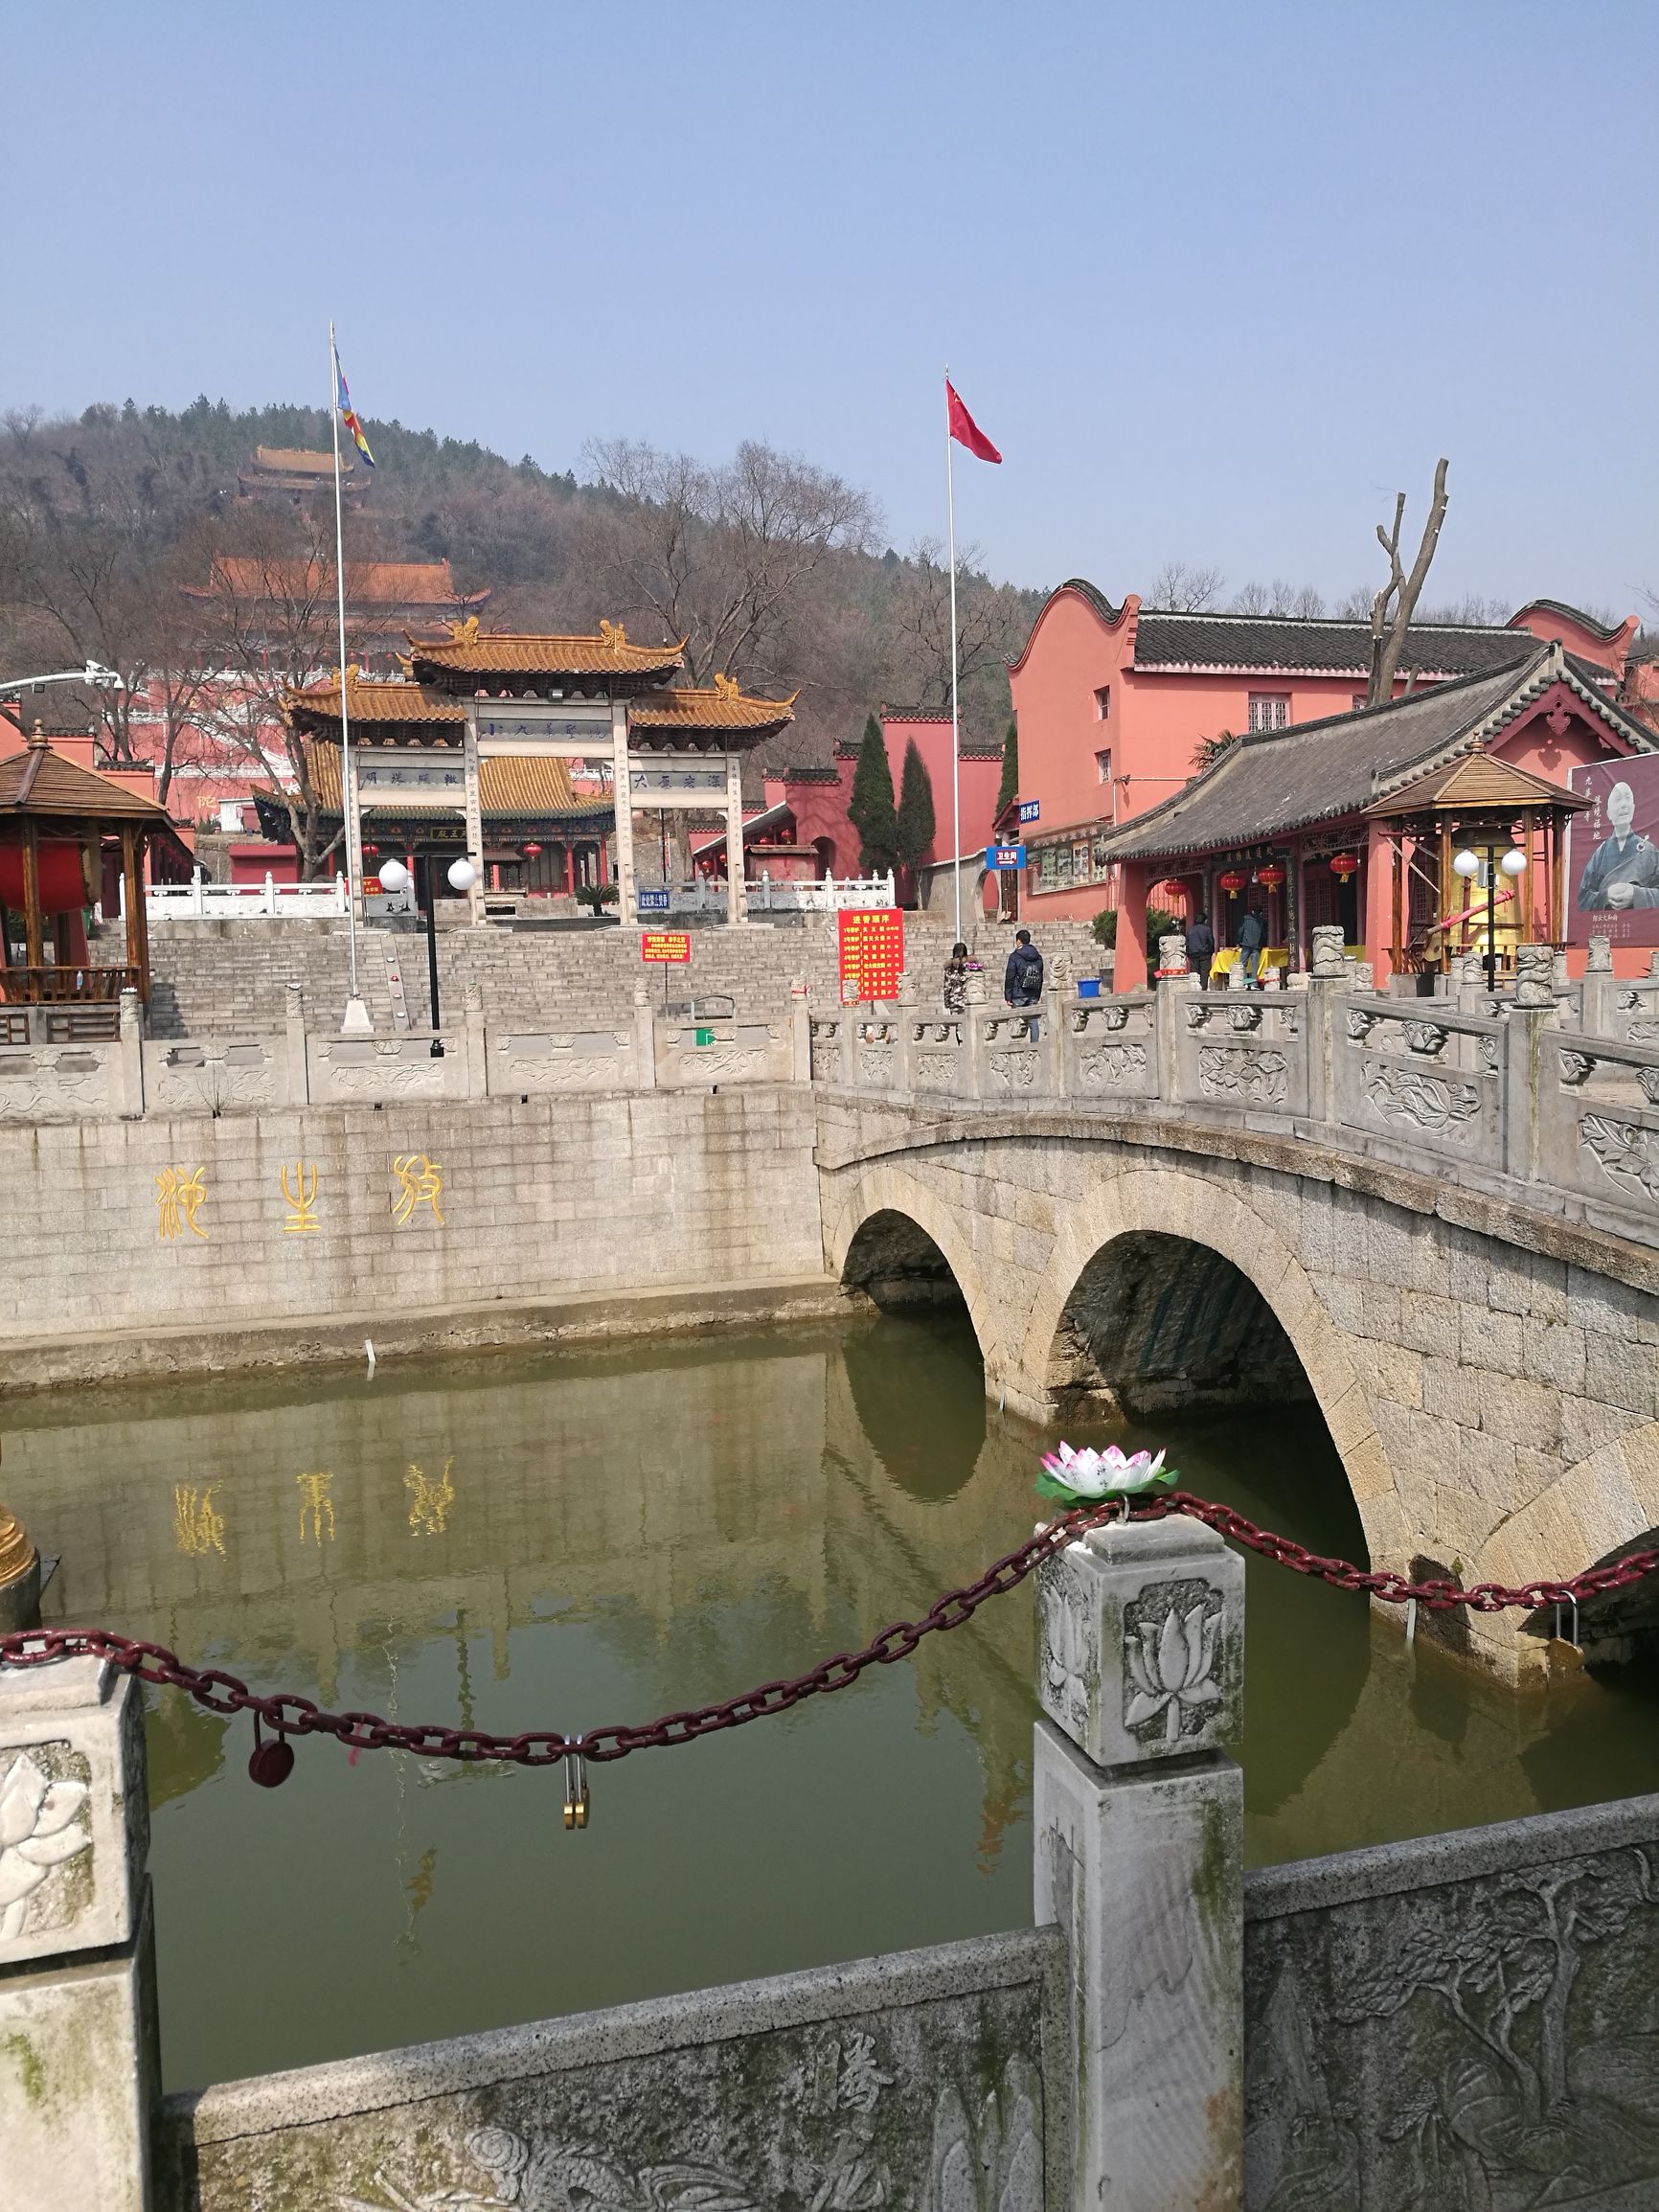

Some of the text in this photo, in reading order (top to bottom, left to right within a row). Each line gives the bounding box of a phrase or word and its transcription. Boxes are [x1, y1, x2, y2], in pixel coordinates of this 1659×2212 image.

[1020, 804, 1038, 821] 指挥部
[996, 851, 1016, 860] 卫生间
[852, 914, 889, 924] 进香顺序
